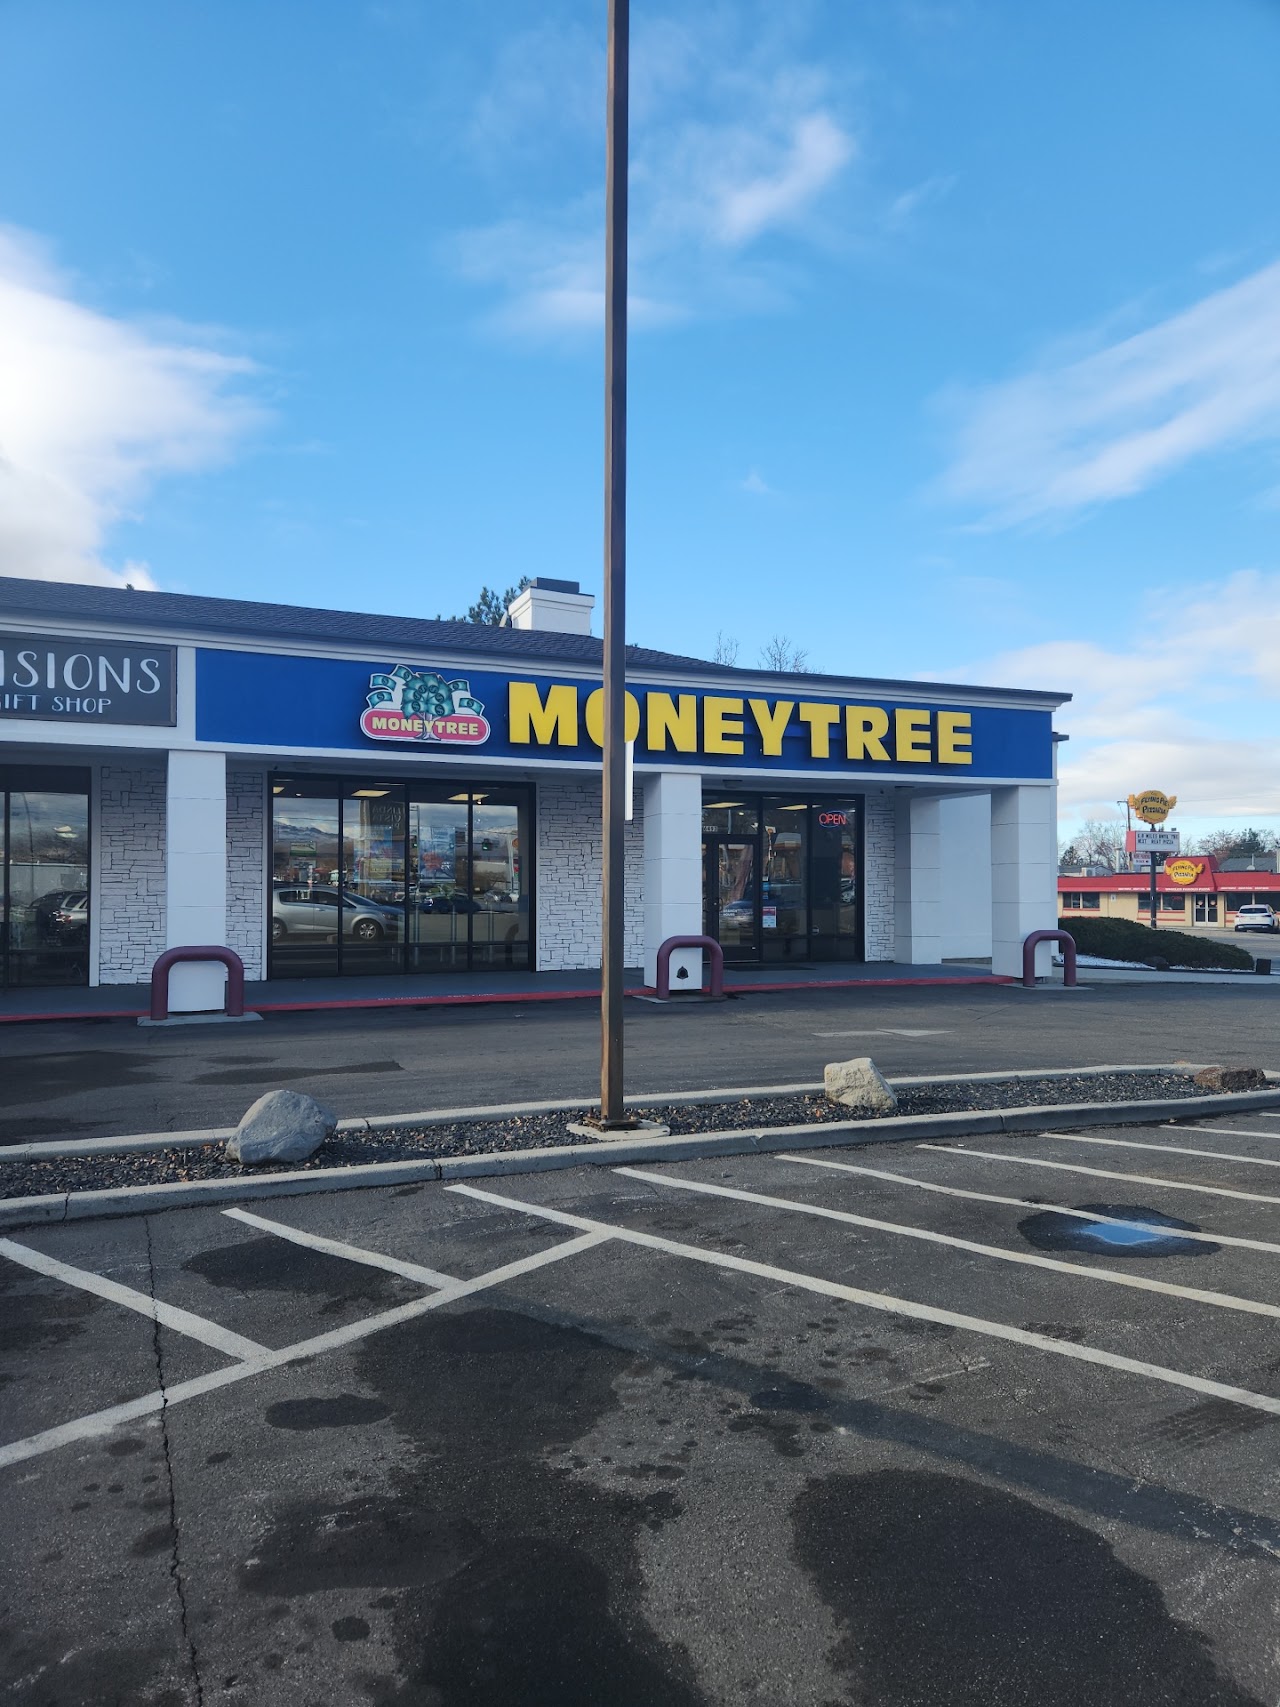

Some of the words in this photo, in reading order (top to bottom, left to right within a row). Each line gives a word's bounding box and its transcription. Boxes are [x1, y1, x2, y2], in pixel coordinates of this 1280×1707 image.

[0, 694, 41, 711] IFT
[51, 696, 112, 714] SHOP
[371, 717, 479, 735] MONEYTREE
[508, 681, 973, 765] MONEYTREE
[818, 813, 846, 825] OPEN
